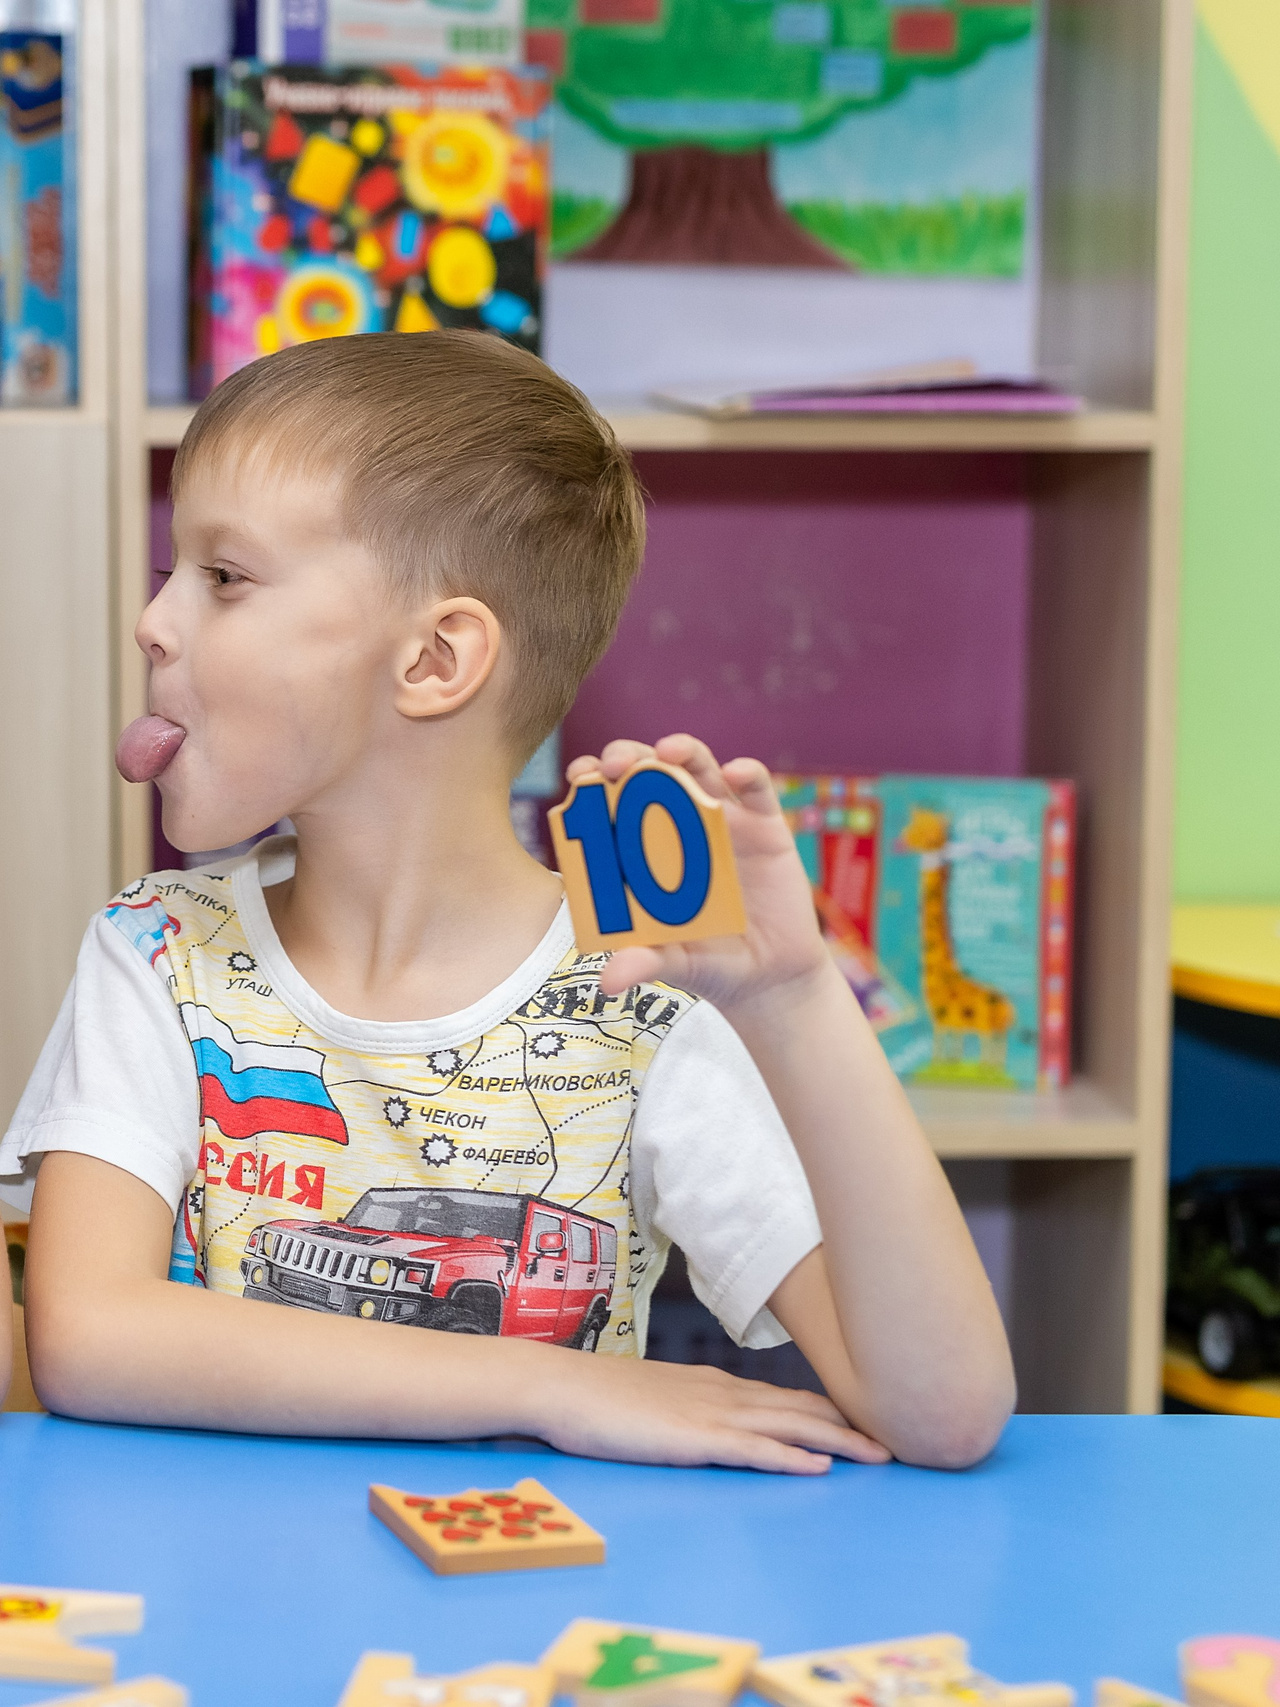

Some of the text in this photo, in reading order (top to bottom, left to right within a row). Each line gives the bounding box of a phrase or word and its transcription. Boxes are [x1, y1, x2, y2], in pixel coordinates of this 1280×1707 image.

[562, 769, 712, 935] 10
[154, 882, 229, 915] СТРЕЛКА
[225, 977, 273, 998] УТАШ
[457, 1069, 632, 1093] ВАРЕНИКОВСКАЯ
[419, 1106, 487, 1130] ЧЕКОН
[462, 1146, 550, 1167] ФАДЕЕВО
